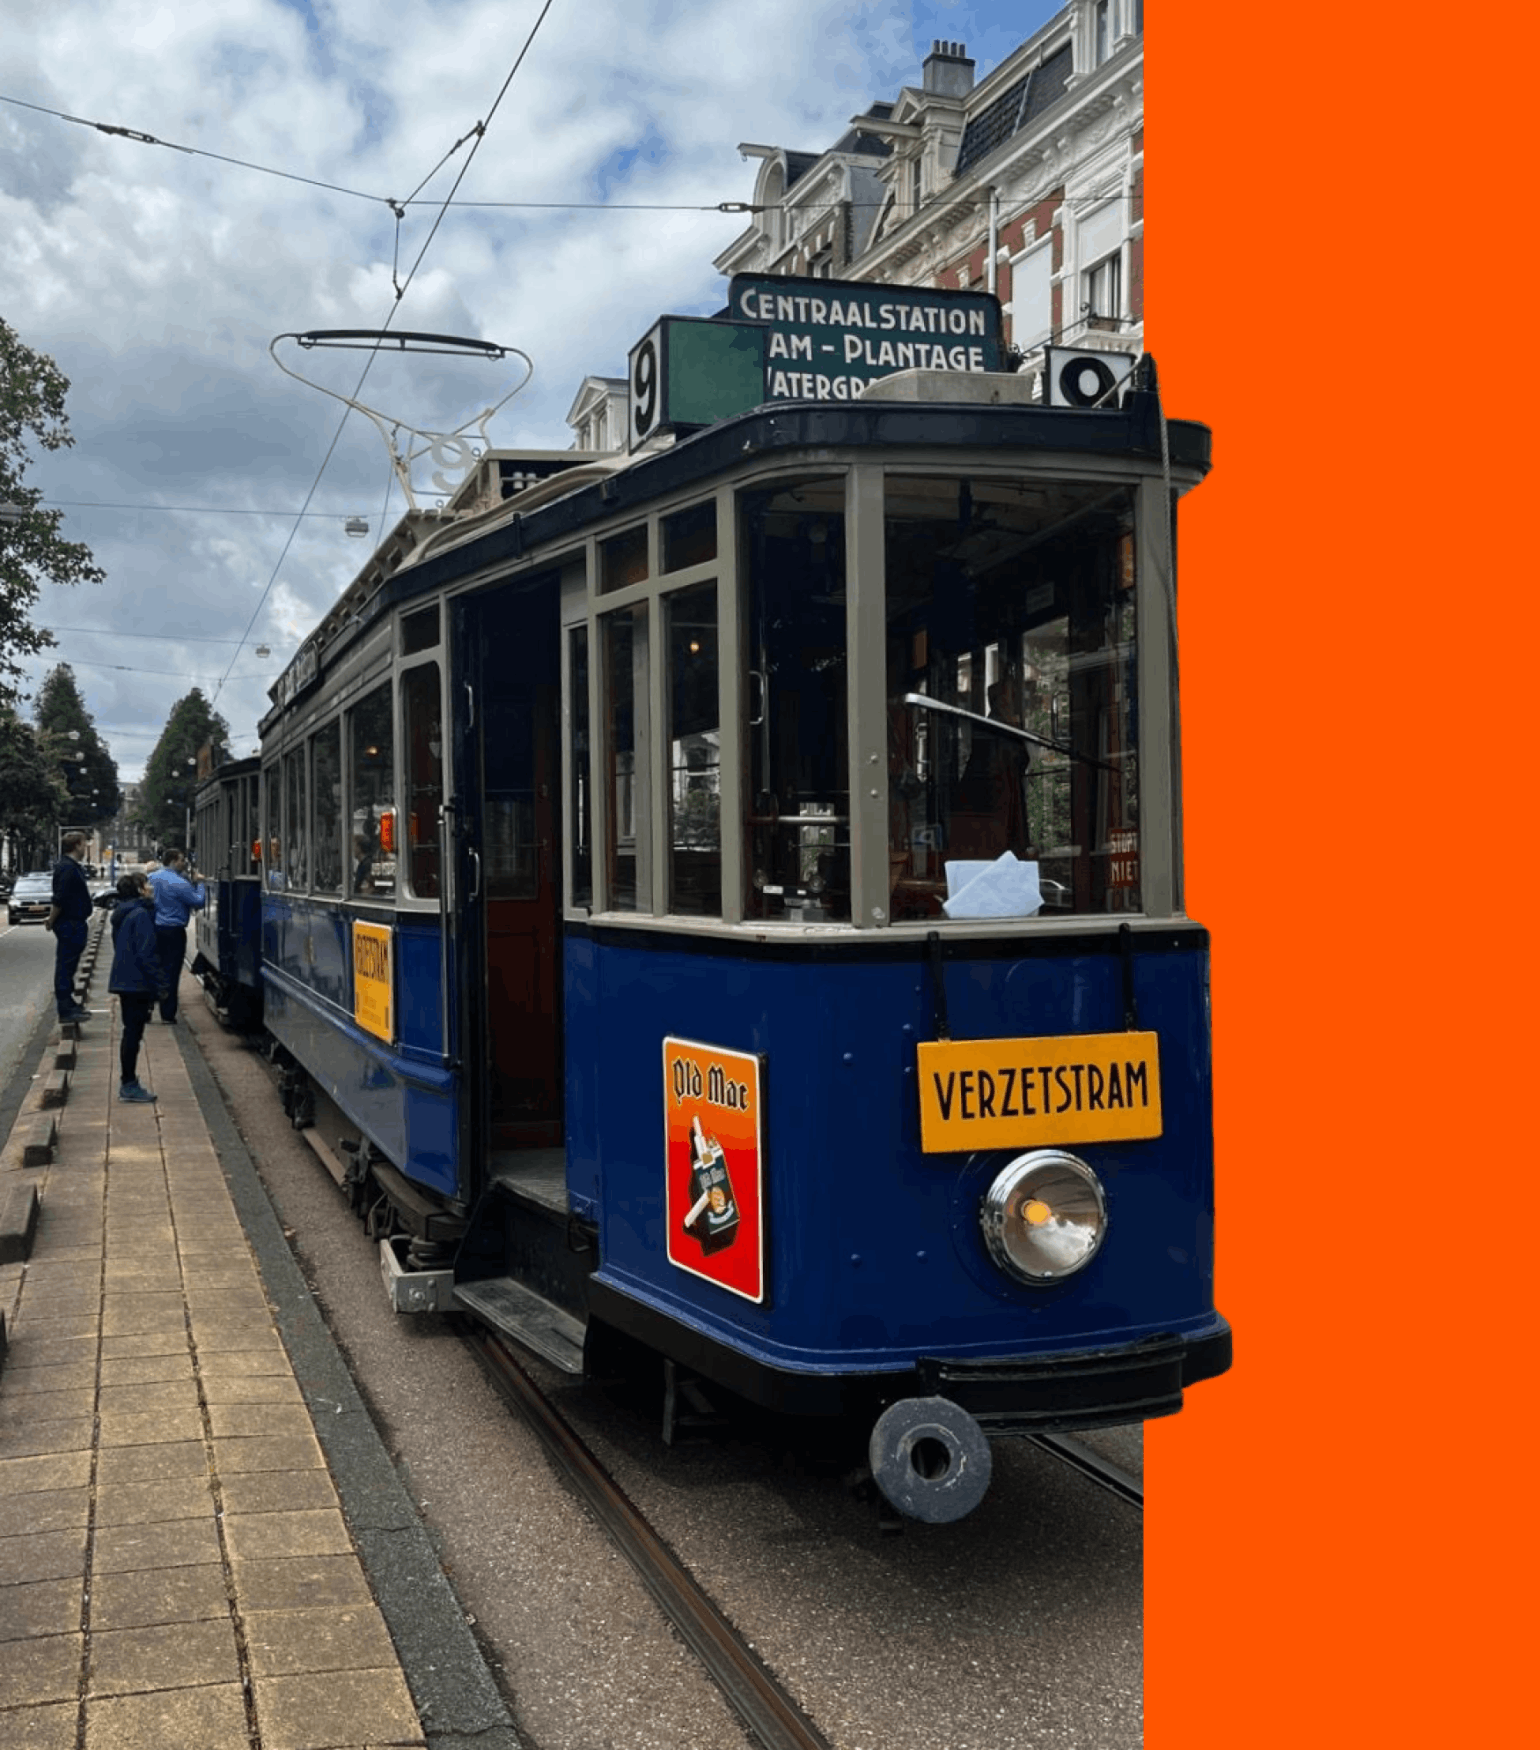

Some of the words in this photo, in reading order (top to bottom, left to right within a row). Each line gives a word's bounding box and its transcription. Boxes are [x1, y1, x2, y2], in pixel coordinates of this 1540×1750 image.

[740, 288, 985, 336] CENTRAALSTATION
[769, 332, 813, 362] AM
[843, 334, 984, 373] PLANTAGE
[635, 338, 657, 437] 9
[767, 366, 880, 400] ATERGR
[1111, 860, 1138, 882] NIET
[672, 1056, 703, 1106] Old
[707, 1062, 749, 1112] Mac
[933, 1060, 1149, 1121] VERZETSTRAM
